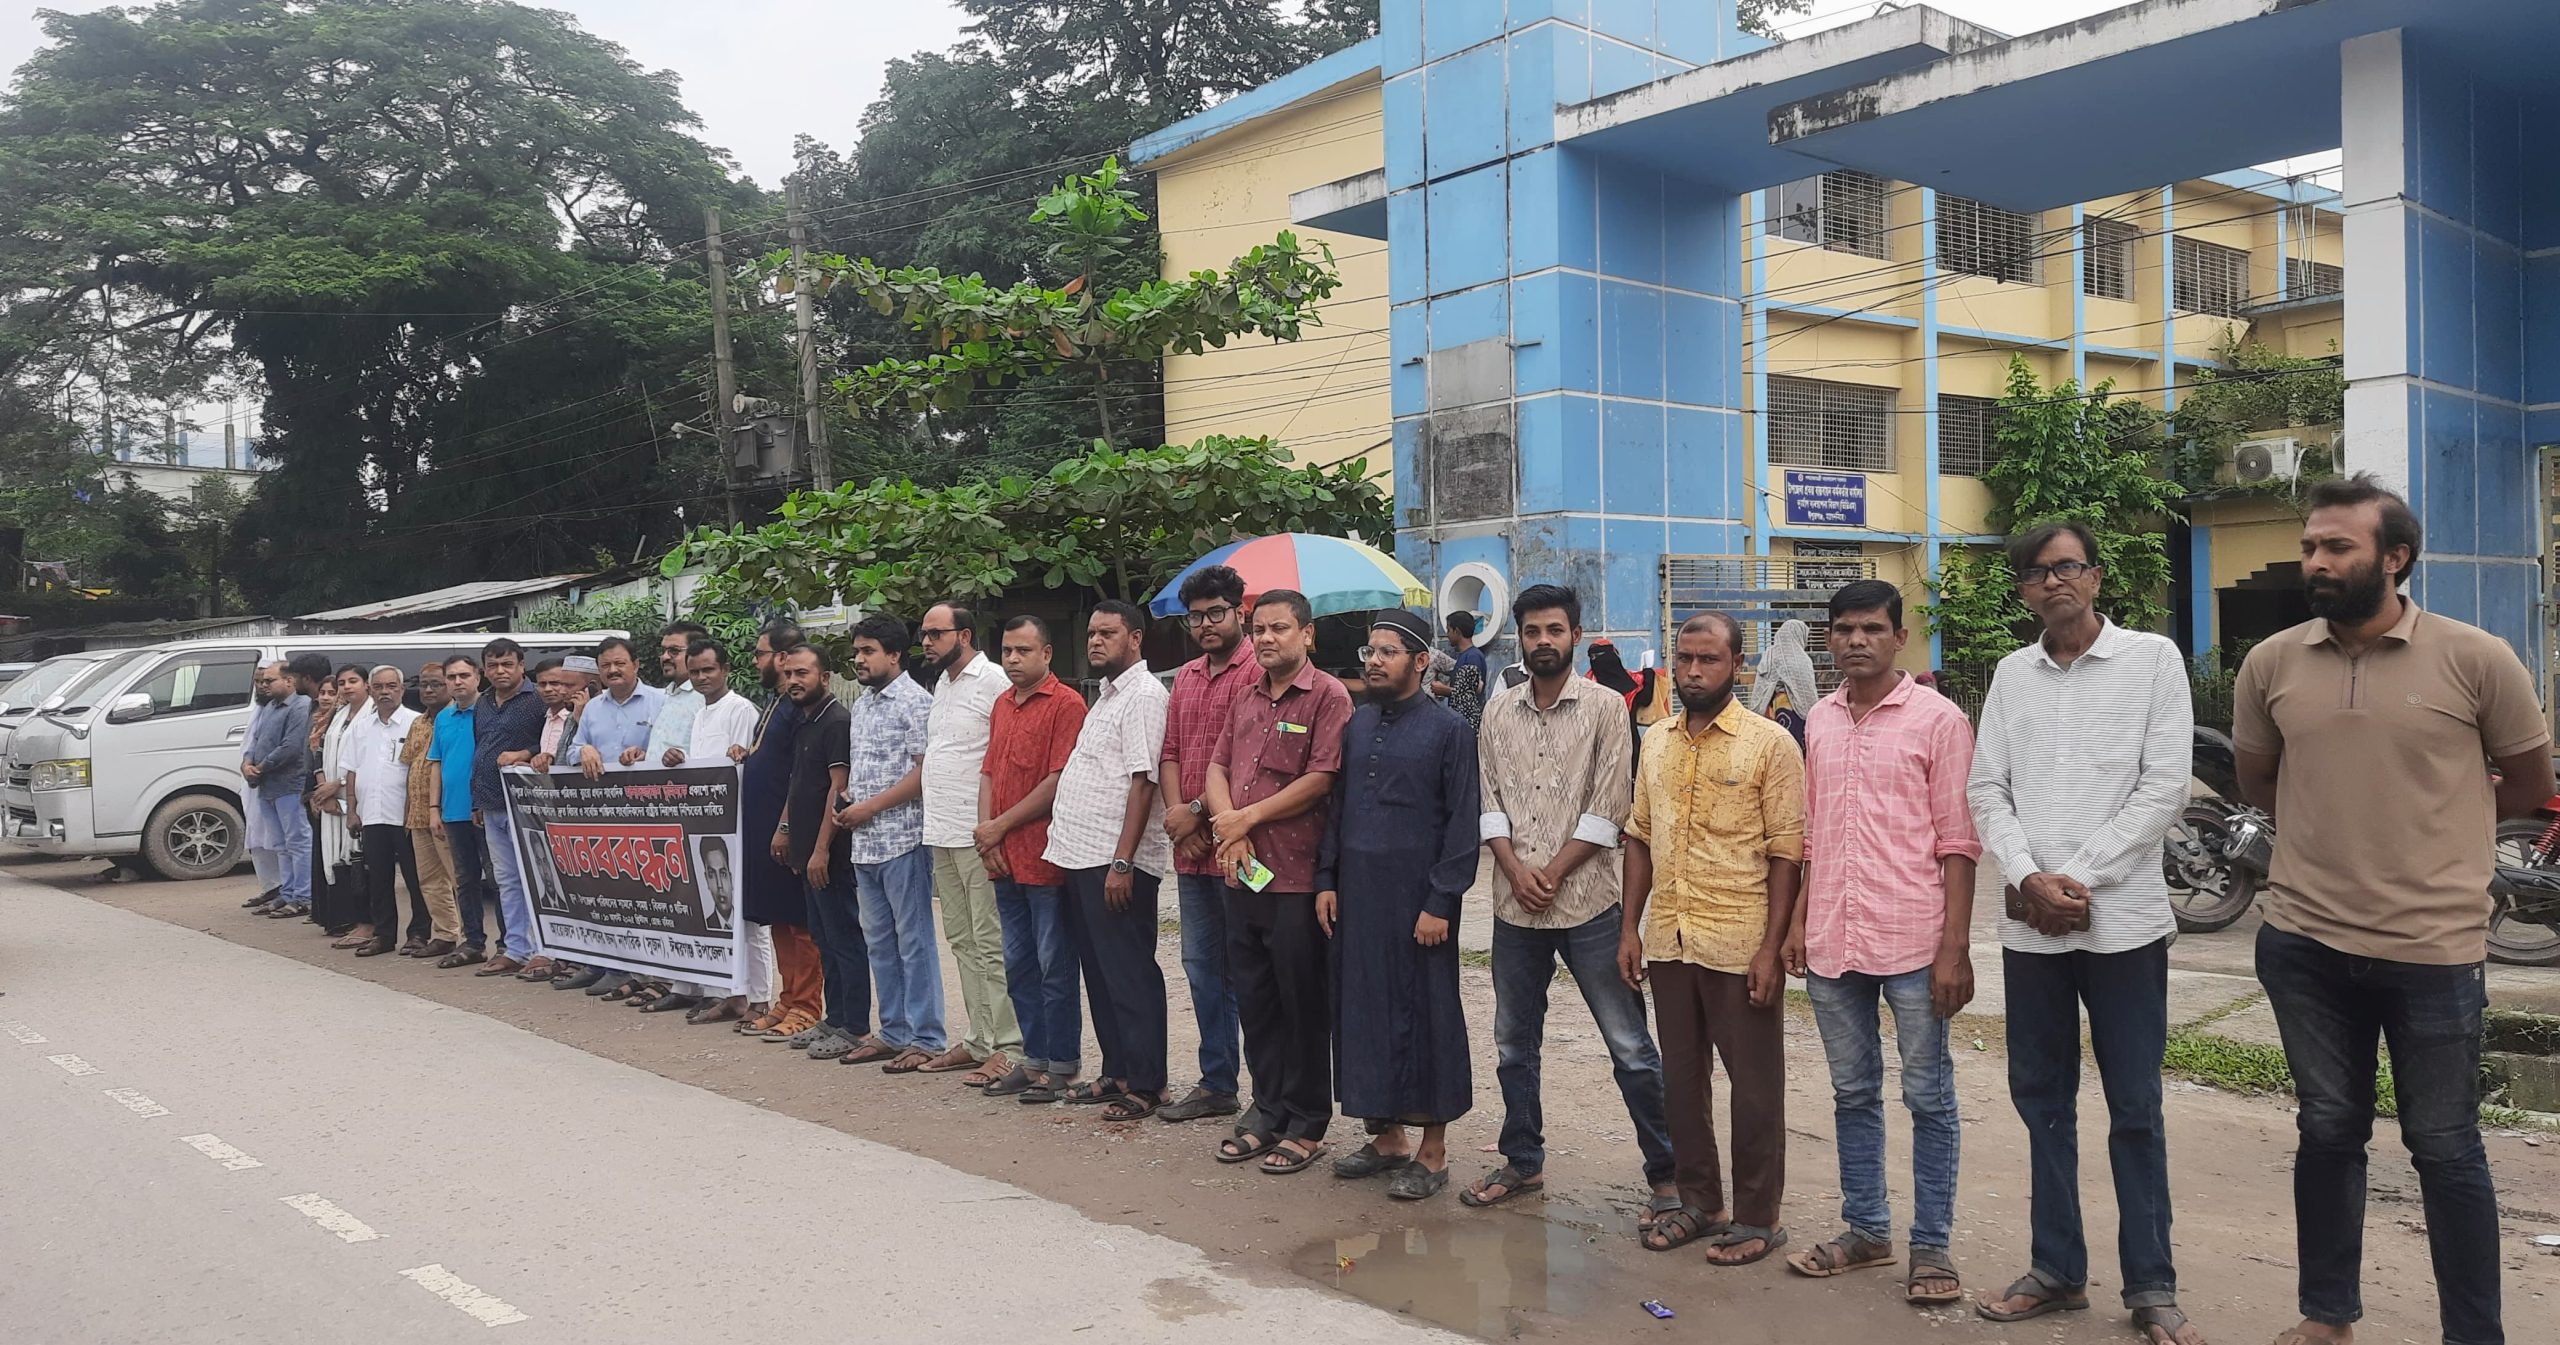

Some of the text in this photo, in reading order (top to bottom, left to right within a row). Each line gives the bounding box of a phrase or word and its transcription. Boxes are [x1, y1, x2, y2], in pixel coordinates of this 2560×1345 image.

[603, 785, 624, 799] সাংবাদিক
[709, 785, 728, 800] নৃশংস
[703, 802, 724, 817] দাবিতে
[545, 822, 690, 893] মানববন্ধন
[616, 931, 642, 952] নাগরিক
[668, 937, 695, 958] ঈশ্বরগঞ্জ
[693, 940, 727, 962] উপজেলা
